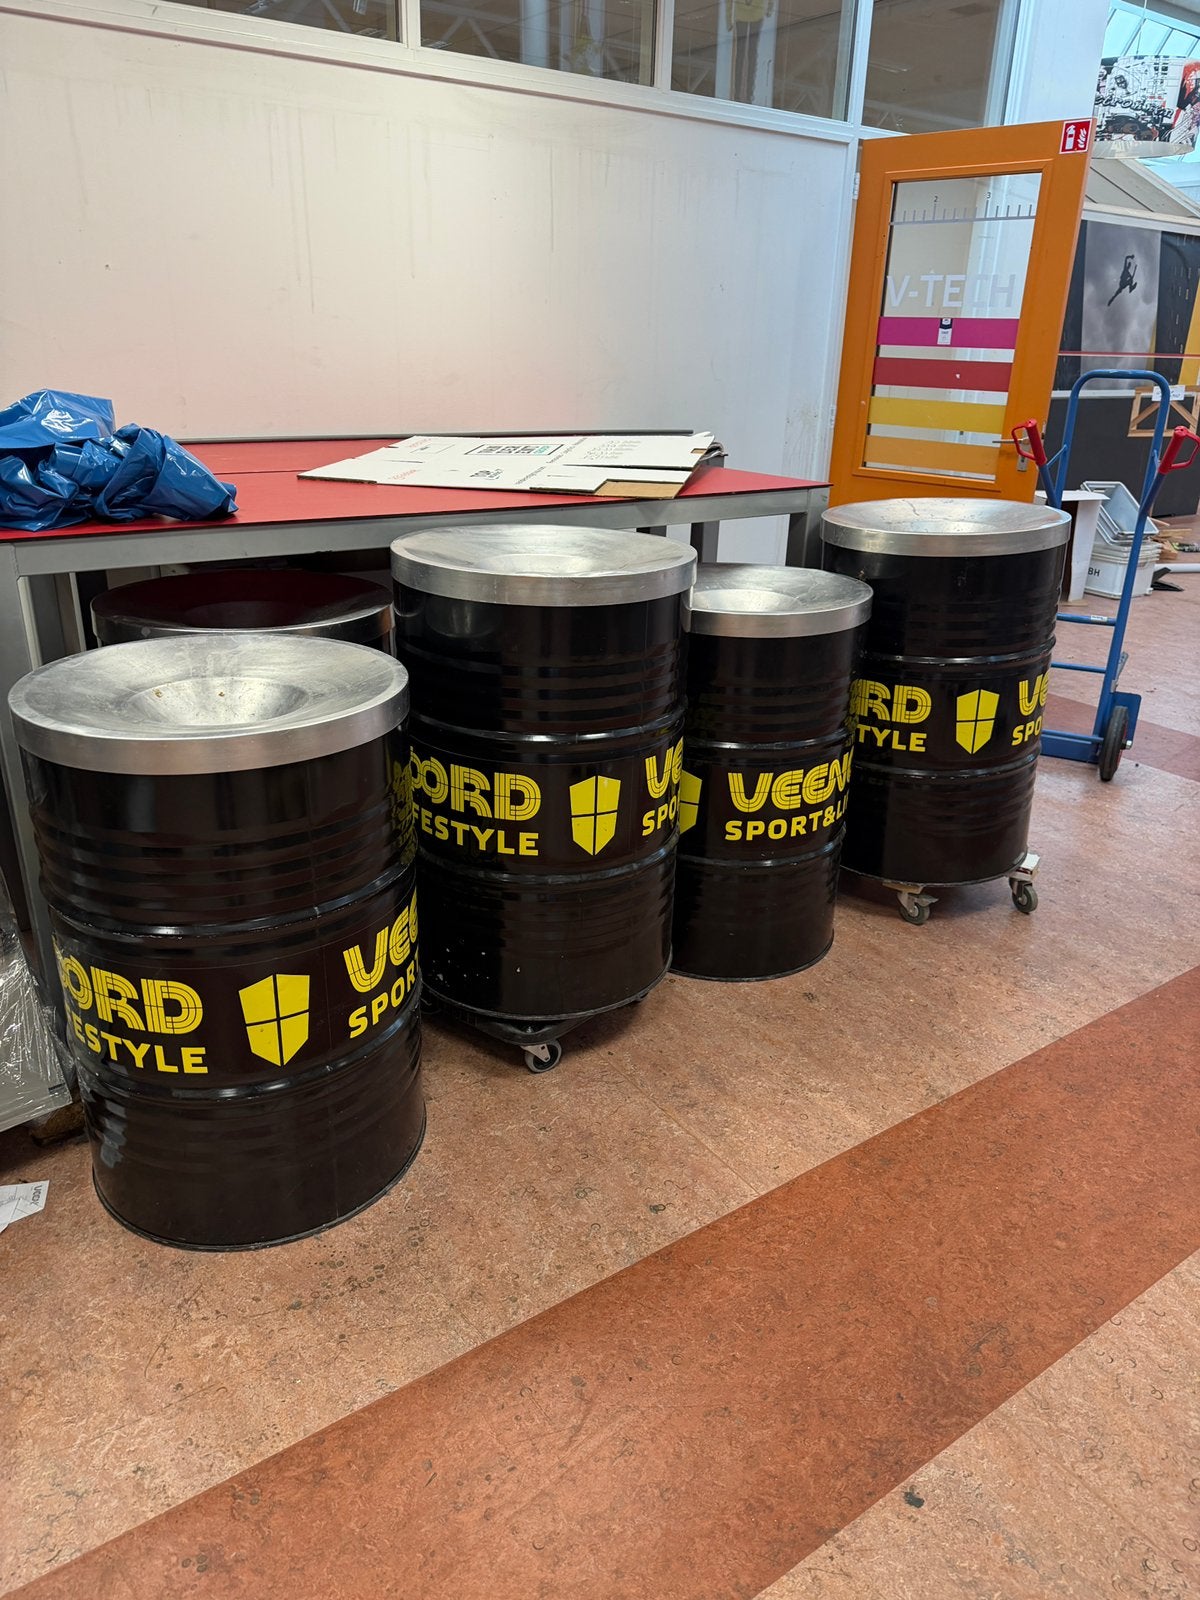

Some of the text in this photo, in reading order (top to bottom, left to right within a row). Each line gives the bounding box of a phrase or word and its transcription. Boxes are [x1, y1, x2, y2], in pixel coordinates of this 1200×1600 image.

[886, 273, 1017, 309] V-TECH
[727, 746, 854, 814] VEEN
[60, 953, 204, 1035] ORD
